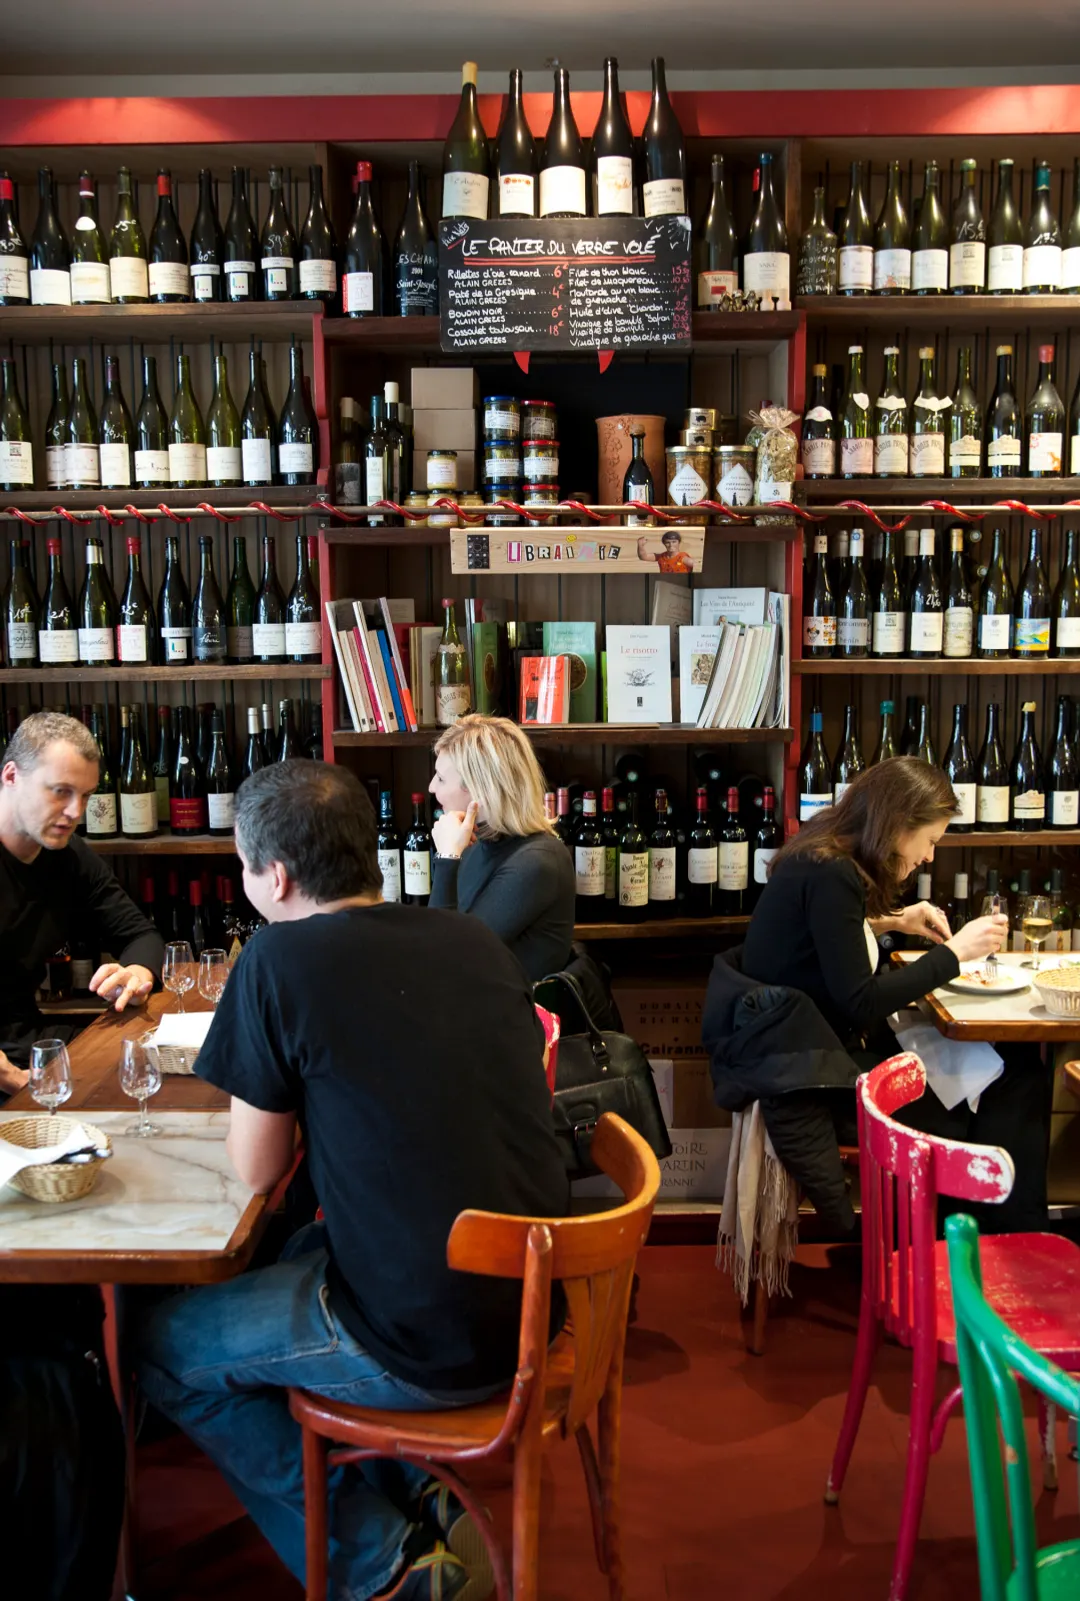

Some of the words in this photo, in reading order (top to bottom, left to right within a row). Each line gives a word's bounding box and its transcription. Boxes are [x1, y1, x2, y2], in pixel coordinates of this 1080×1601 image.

[462, 239, 487, 256] LE
[488, 237, 545, 256] PANIER
[547, 240, 566, 255] DU
[572, 239, 618, 255] VERRE
[623, 234, 661, 254] VOLÉ
[447, 269, 480, 280] Rillettes
[568, 268, 589, 278] Filet
[590, 268, 601, 278] de
[601, 267, 620, 276] thon
[622, 266, 647, 276] blanc
[454, 280, 480, 289] ALAIN
[568, 278, 590, 288] Filet
[591, 278, 601, 287] de
[603, 276, 655, 288] maquereau
[472, 288, 483, 298] de
[484, 288, 493, 297] la
[569, 288, 608, 298] Moutarde
[638, 286, 660, 294] blanc
[455, 297, 478, 306] ALAIN
[571, 296, 582, 306] de
[586, 295, 628, 308] grenache
[569, 307, 597, 318] Huile
[454, 318, 477, 326] ALAIN
[604, 319, 614, 327] de
[447, 327, 487, 338] Cassoulet
[603, 326, 613, 334] de
[453, 338, 477, 347] ALAIN
[570, 338, 610, 350] Vinaigre
[612, 335, 622, 344] de
[507, 541, 621, 563] LIBRAIRIE
[620, 645, 631, 654] Le
[632, 646, 658, 654] risotto
[662, 1160, 706, 1172] ARTIN
[661, 1177, 695, 1187] RANNE
